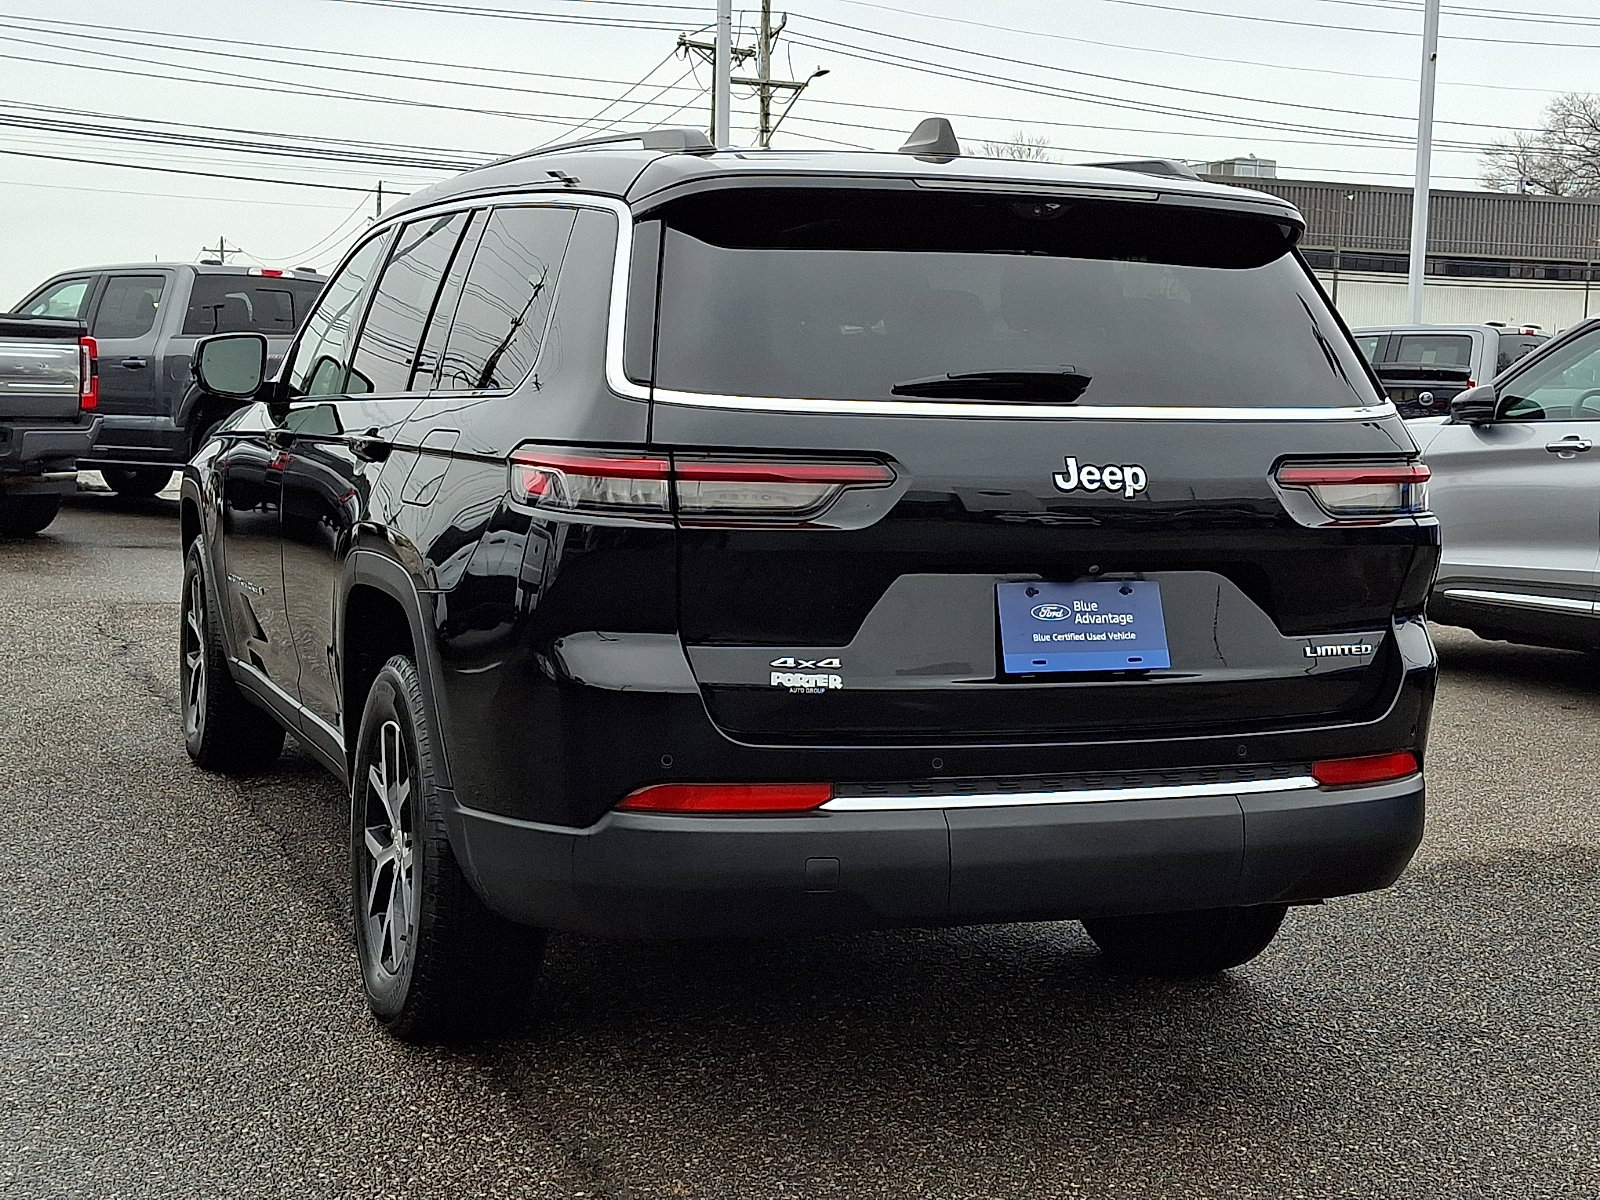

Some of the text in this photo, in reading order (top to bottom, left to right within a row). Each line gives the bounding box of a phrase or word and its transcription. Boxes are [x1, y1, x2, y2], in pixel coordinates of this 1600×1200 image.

[1053, 456, 1147, 498] Jeep
[1036, 606, 1066, 618] Ford
[1073, 601, 1098, 612] Blue
[1074, 613, 1134, 625] Advantage
[1033, 632, 1137, 642] Blue Certified Used Vehicle
[1304, 644, 1372, 657] LIMITED
[769, 657, 842, 669] 4x4
[770, 672, 843, 689] PORTER
